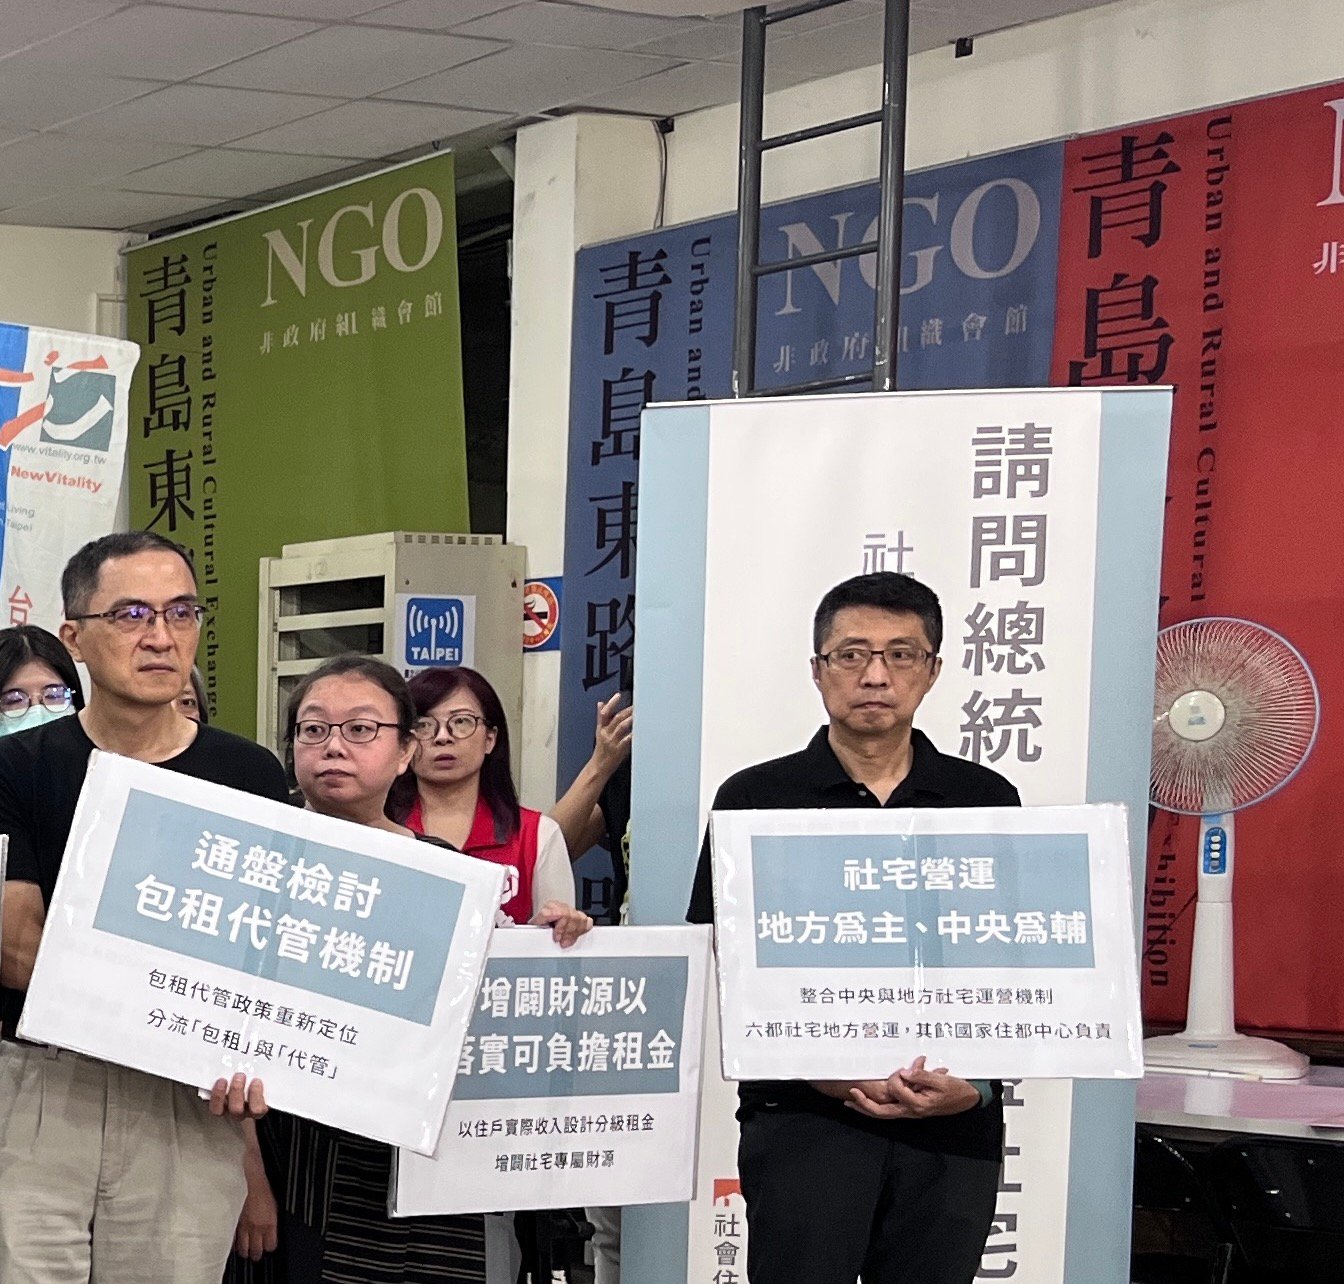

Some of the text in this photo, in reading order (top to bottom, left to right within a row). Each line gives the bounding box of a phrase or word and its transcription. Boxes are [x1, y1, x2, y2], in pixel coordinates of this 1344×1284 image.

[1205, 115, 1232, 231] Urban
[202, 241, 218, 324] Urban
[261, 187, 443, 307] NGO
[689, 235, 712, 335] Urban
[775, 178, 1041, 316] NGO
[1202, 247, 1224, 313] and
[139, 253, 195, 560] 青島東
[202, 335, 216, 382] and
[1199, 327, 1223, 432] Rural
[202, 392, 217, 465] Rural
[202, 476, 218, 585] Cultural
[1190, 447, 1216, 602] Cultural
[958, 422, 1053, 764] 請問總統
[411, 646, 459, 661] TAIPEI
[191, 830, 382, 919] 通盤檢討
[843, 856, 996, 892] 社宅營運
[134, 874, 414, 991] 包租代管機制
[148, 968, 360, 1046] 包租代管政策重新定位
[480, 975, 648, 1018] 增闢財源以
